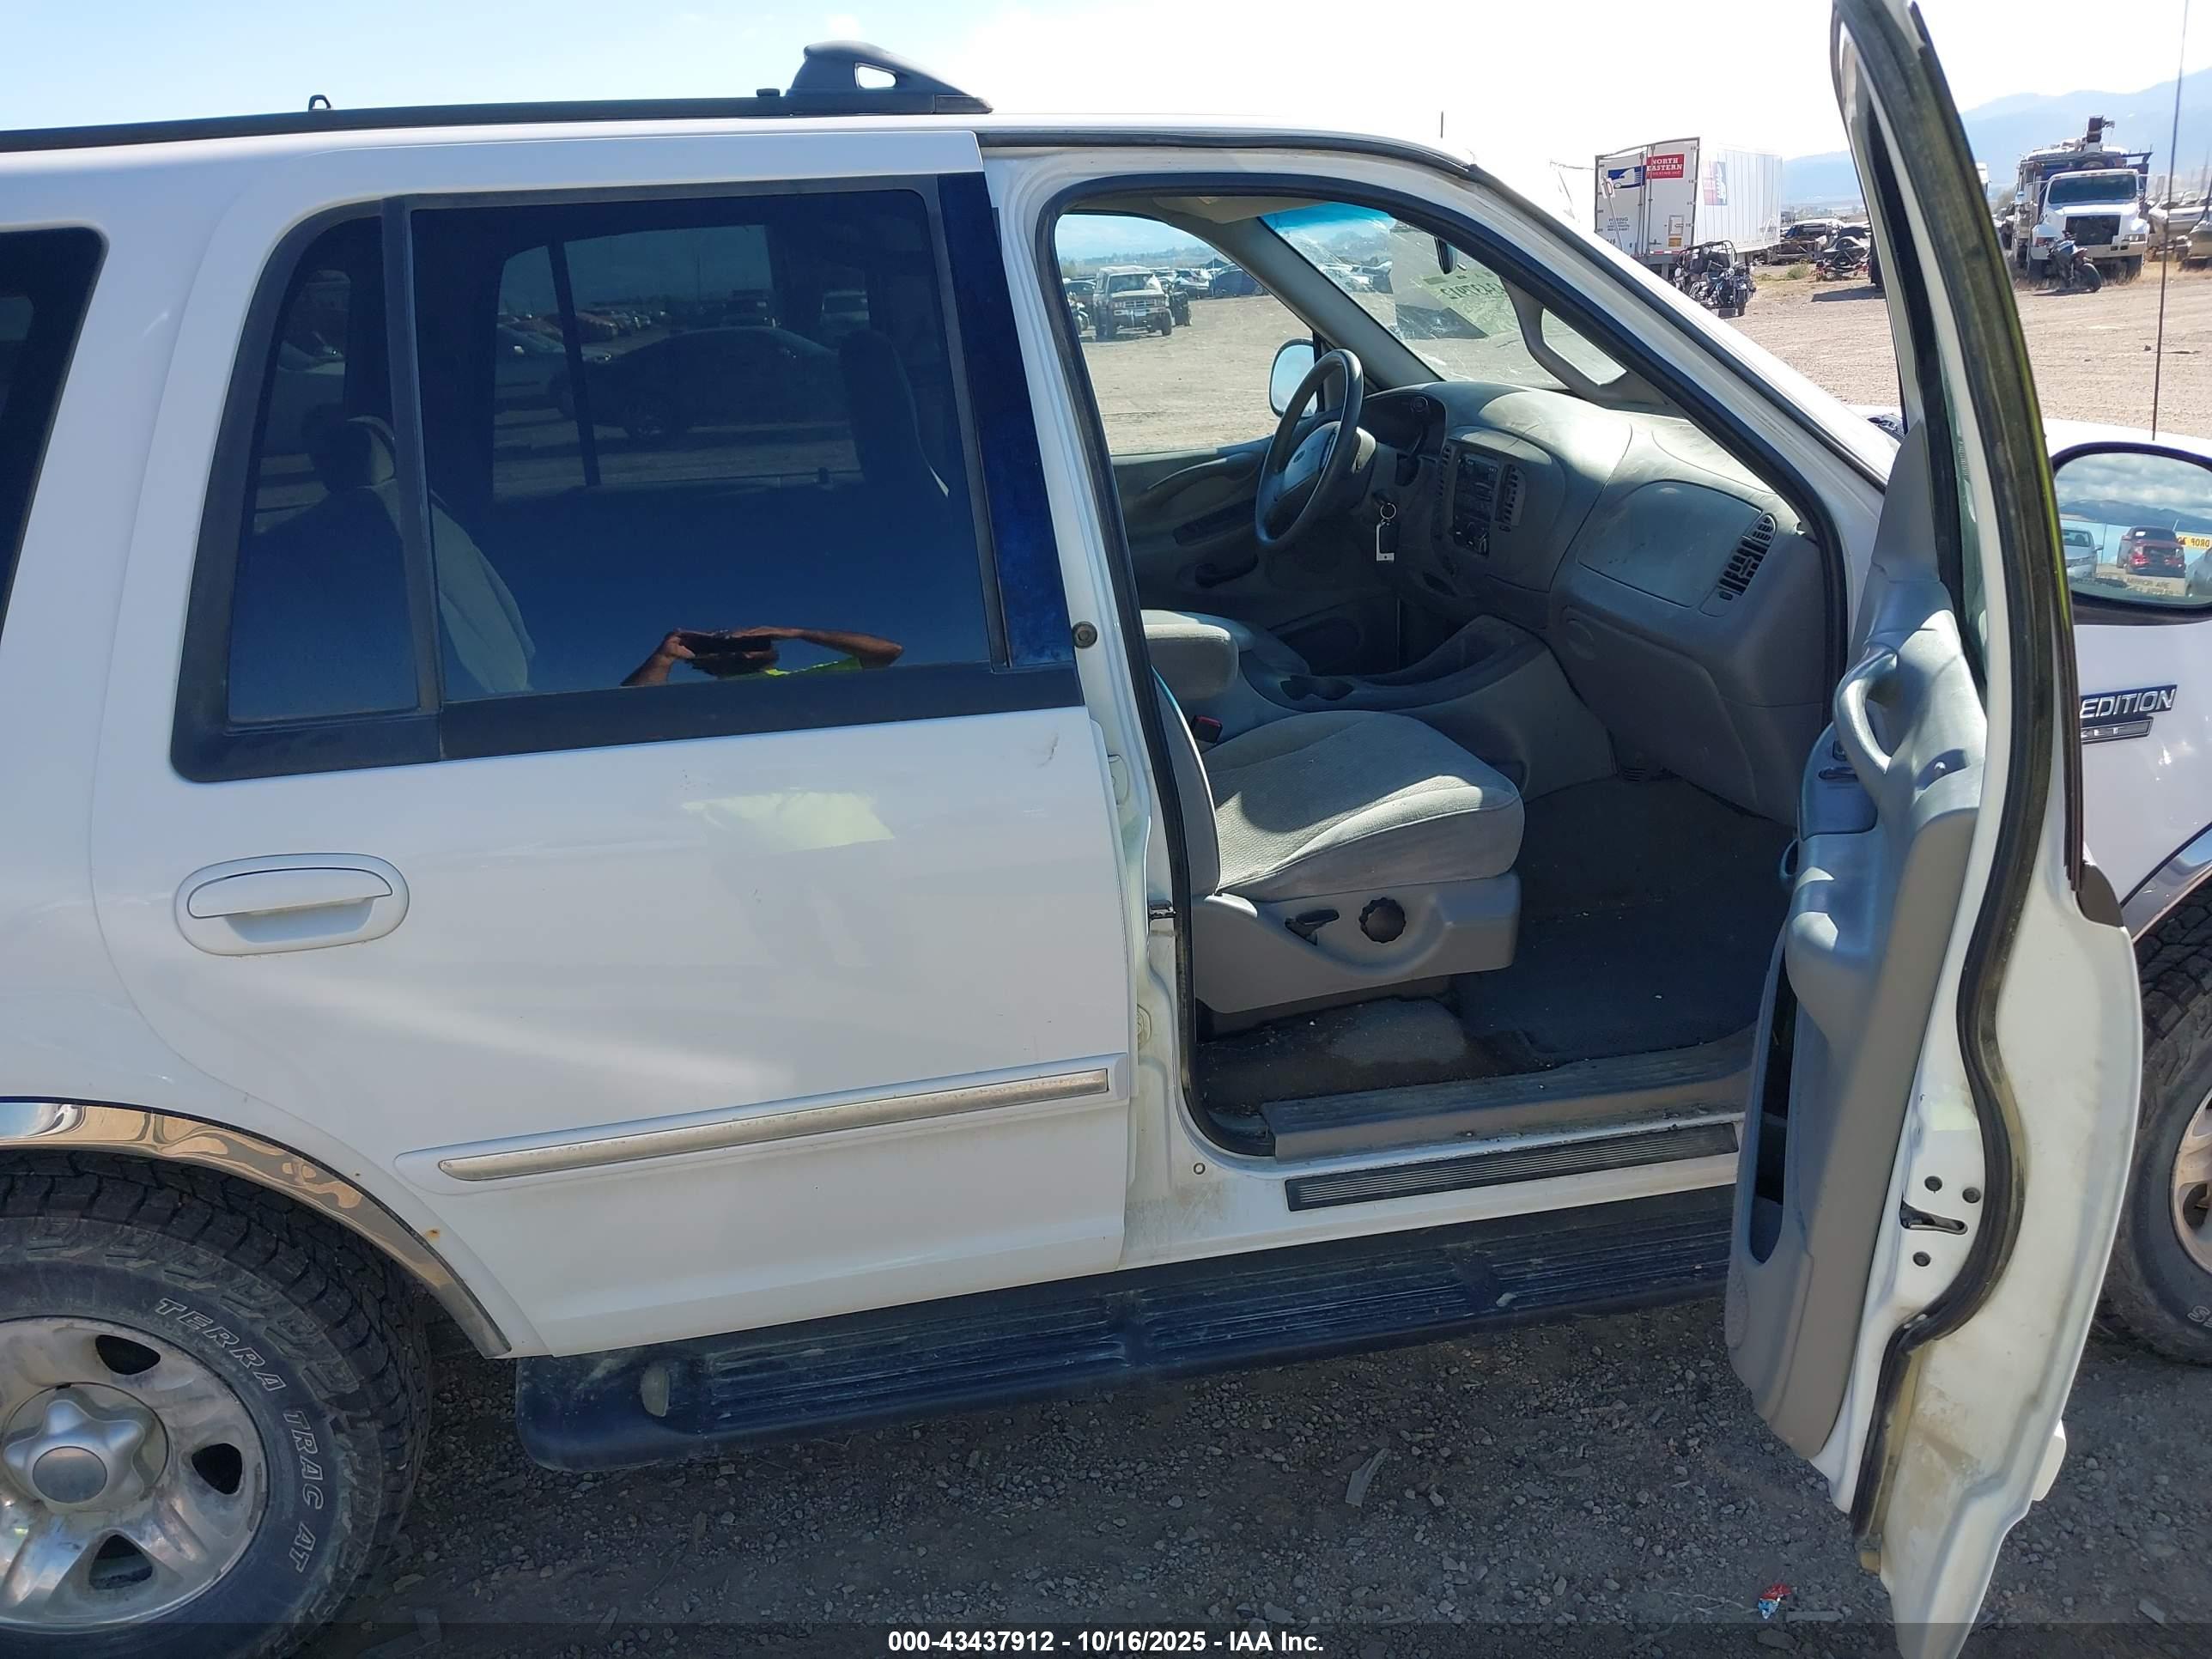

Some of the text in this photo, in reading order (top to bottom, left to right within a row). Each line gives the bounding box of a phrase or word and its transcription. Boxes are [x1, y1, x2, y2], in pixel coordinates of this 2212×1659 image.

[154, 1297, 324, 1574] TERRA TRAC AT
